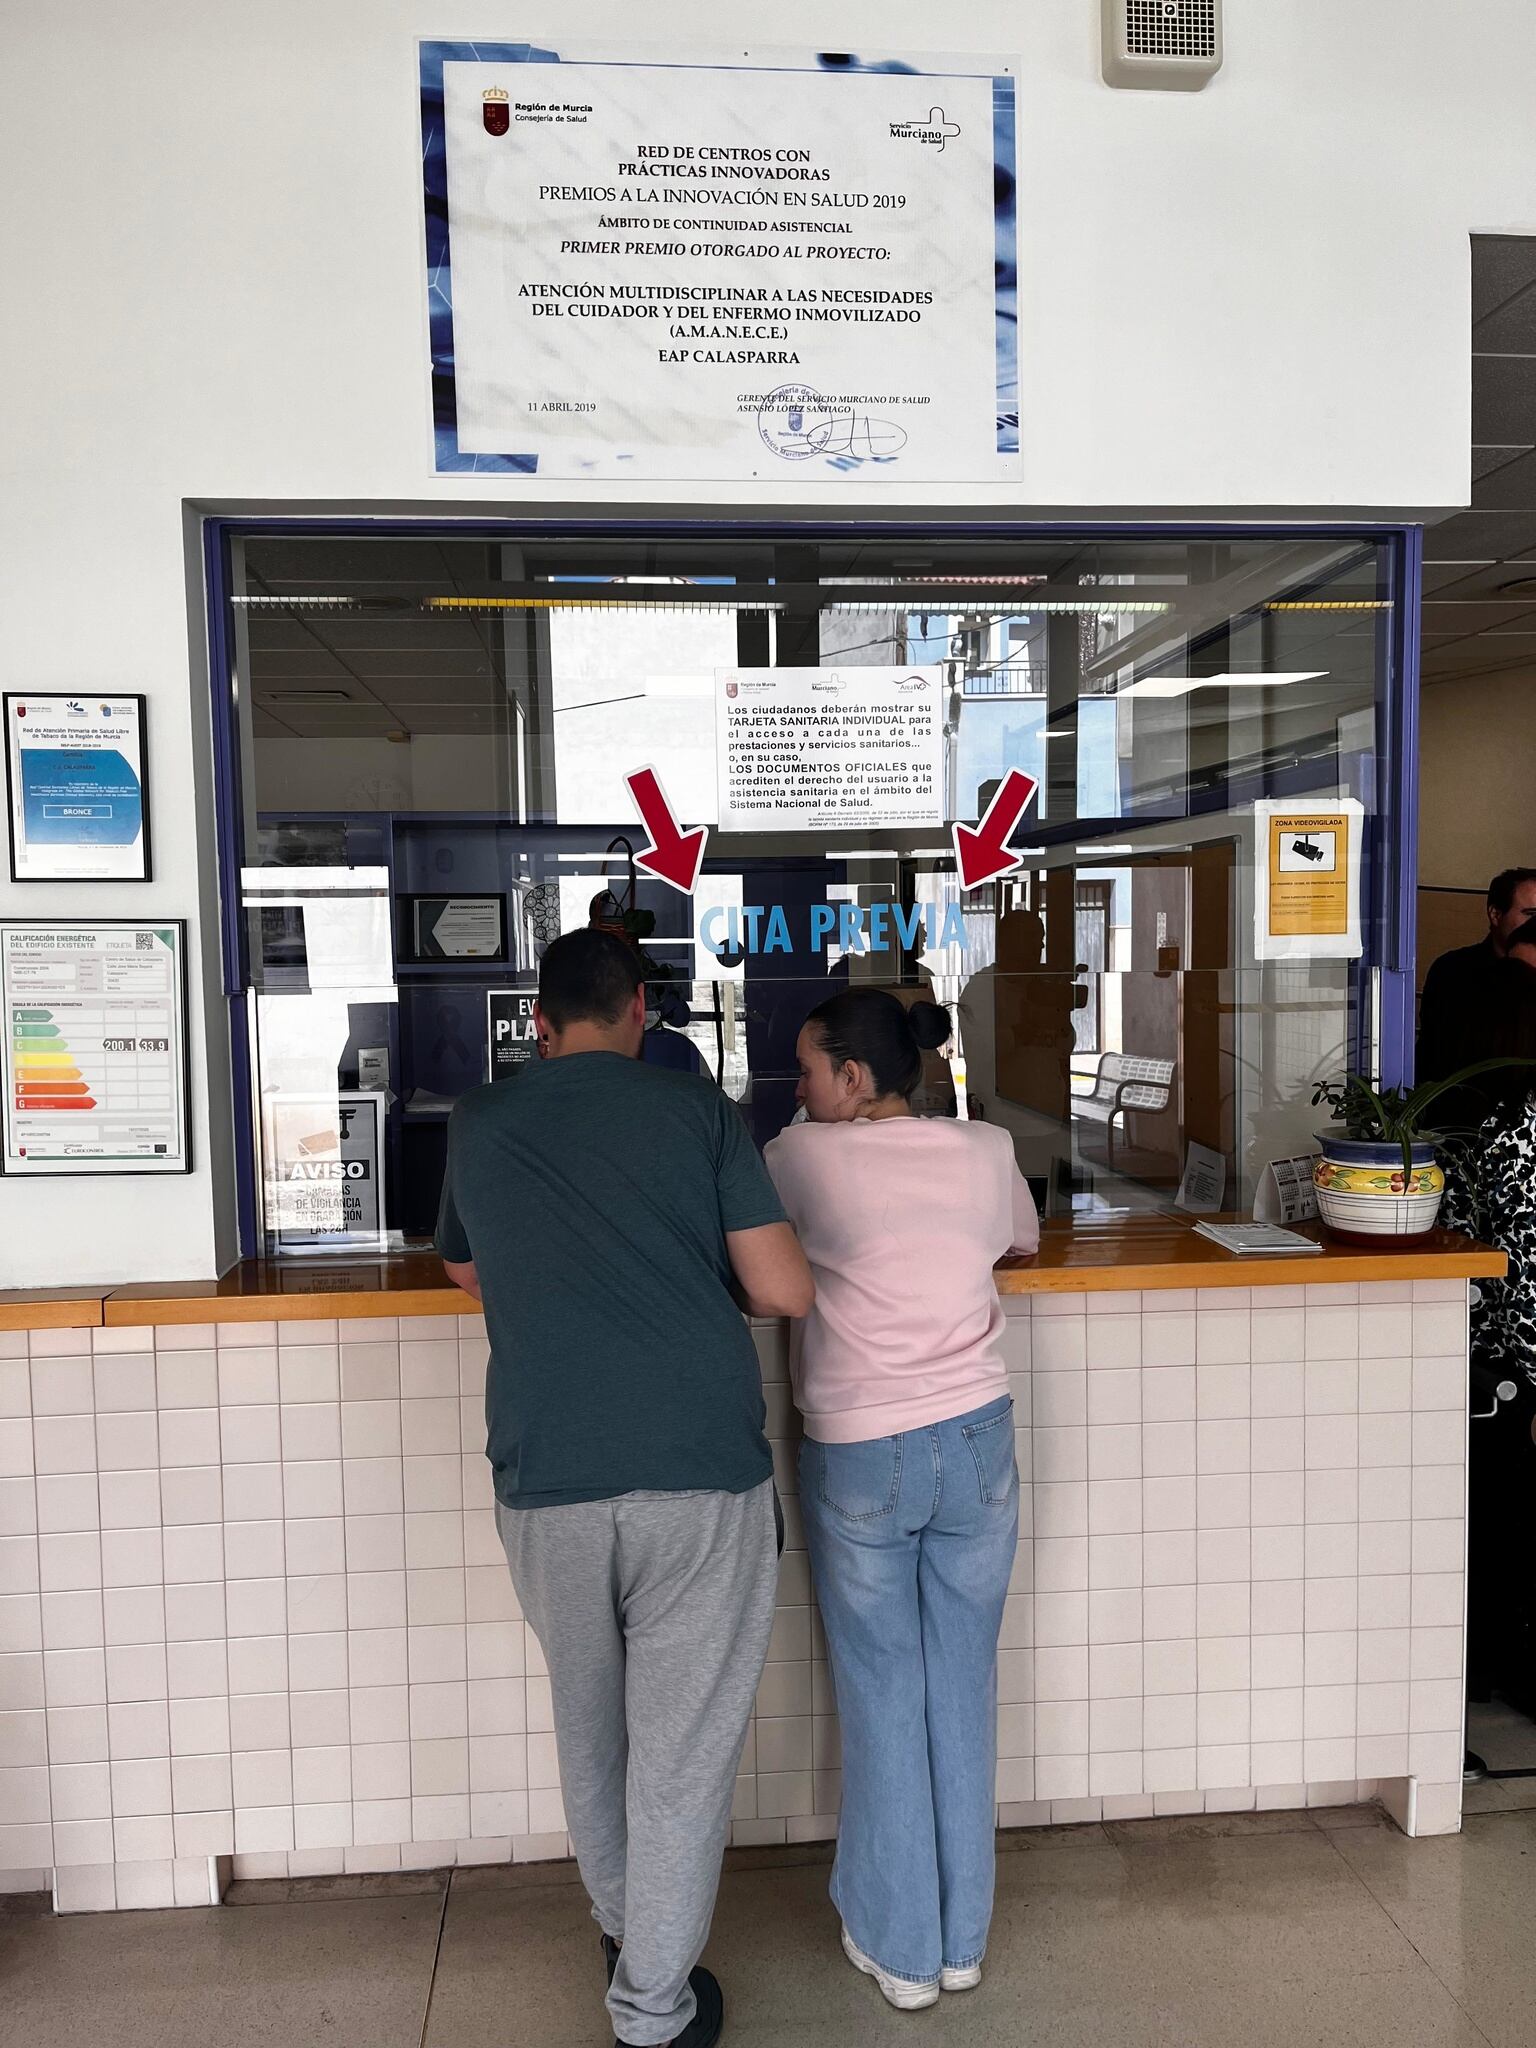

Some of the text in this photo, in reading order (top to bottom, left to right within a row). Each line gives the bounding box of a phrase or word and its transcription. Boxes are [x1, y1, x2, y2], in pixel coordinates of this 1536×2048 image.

[515, 103, 546, 112] Región
[515, 114, 553, 123] Consejería
[890, 129, 942, 138] Murciano
[638, 145, 810, 162] RED DE CENTROS CON
[619, 160, 830, 181] PRÁCTICAS INNOVADORAS
[540, 186, 906, 209] PREMIOS A LA INNOVACIÓN EN SALUD 2019
[598, 214, 853, 233] ÁMBITO DE CONTINUIDAD ASISTENCIAL
[561, 240, 890, 260] PRIMER PREMIO OTORGADO AL PROYECTO:
[518, 281, 933, 304] ATENCIÓN MULTIDISCIPLINAR A LAS NECESIDADES
[532, 303, 921, 323] DEL CUIDADOR Y DEL ENFERMO INMOVILIZADO
[670, 325, 788, 340] (A.M.A.N.E.C.E.)
[659, 349, 800, 364] EAP CALASPARRA
[737, 394, 777, 402] GERENTE
[797, 395, 837, 403] SERVICIO
[839, 395, 887, 403] MURCIANO
[902, 396, 931, 404] SALUD
[528, 402, 596, 412] 11 ABRIL 2019
[728, 706, 748, 715] Los
[752, 705, 817, 715] ciudadanos
[822, 704, 866, 714] deberán
[871, 704, 914, 713] mostrar
[728, 715, 931, 726] TARJETA SANITARIA INDIVIDUAL para
[729, 729, 739, 738] el
[748, 730, 794, 738] acceso
[818, 728, 848, 737] cada
[858, 729, 880, 737] una
[890, 727, 904, 736] de
[914, 727, 931, 736] las
[729, 739, 920, 751] prestaciones y servicios sanitarios...
[729, 755, 738, 763] o,
[774, 754, 801, 762] caso,
[730, 762, 932, 774] LOS DOCUMENTOS OFICIALES que
[730, 773, 932, 786] acrediten el derecho del usuario a la
[730, 785, 932, 797] asistencia sanitaria en el ámbito del
[730, 798, 872, 809] Sistema Nacional de Salud.
[63, 808, 93, 816] BRONCE
[700, 902, 970, 954] CITA PREVIA
[10, 934, 97, 942] CALIFICACIÓN ENERGÉTICA
[519, 998, 539, 1016] EV
[16, 1012, 23, 1021] A
[105, 1040, 135, 1051] 200.1
[141, 1040, 165, 1051] 33.9
[290, 1162, 364, 1179] AVISO
[296, 1197, 361, 1209] DE VIGILANCIA
